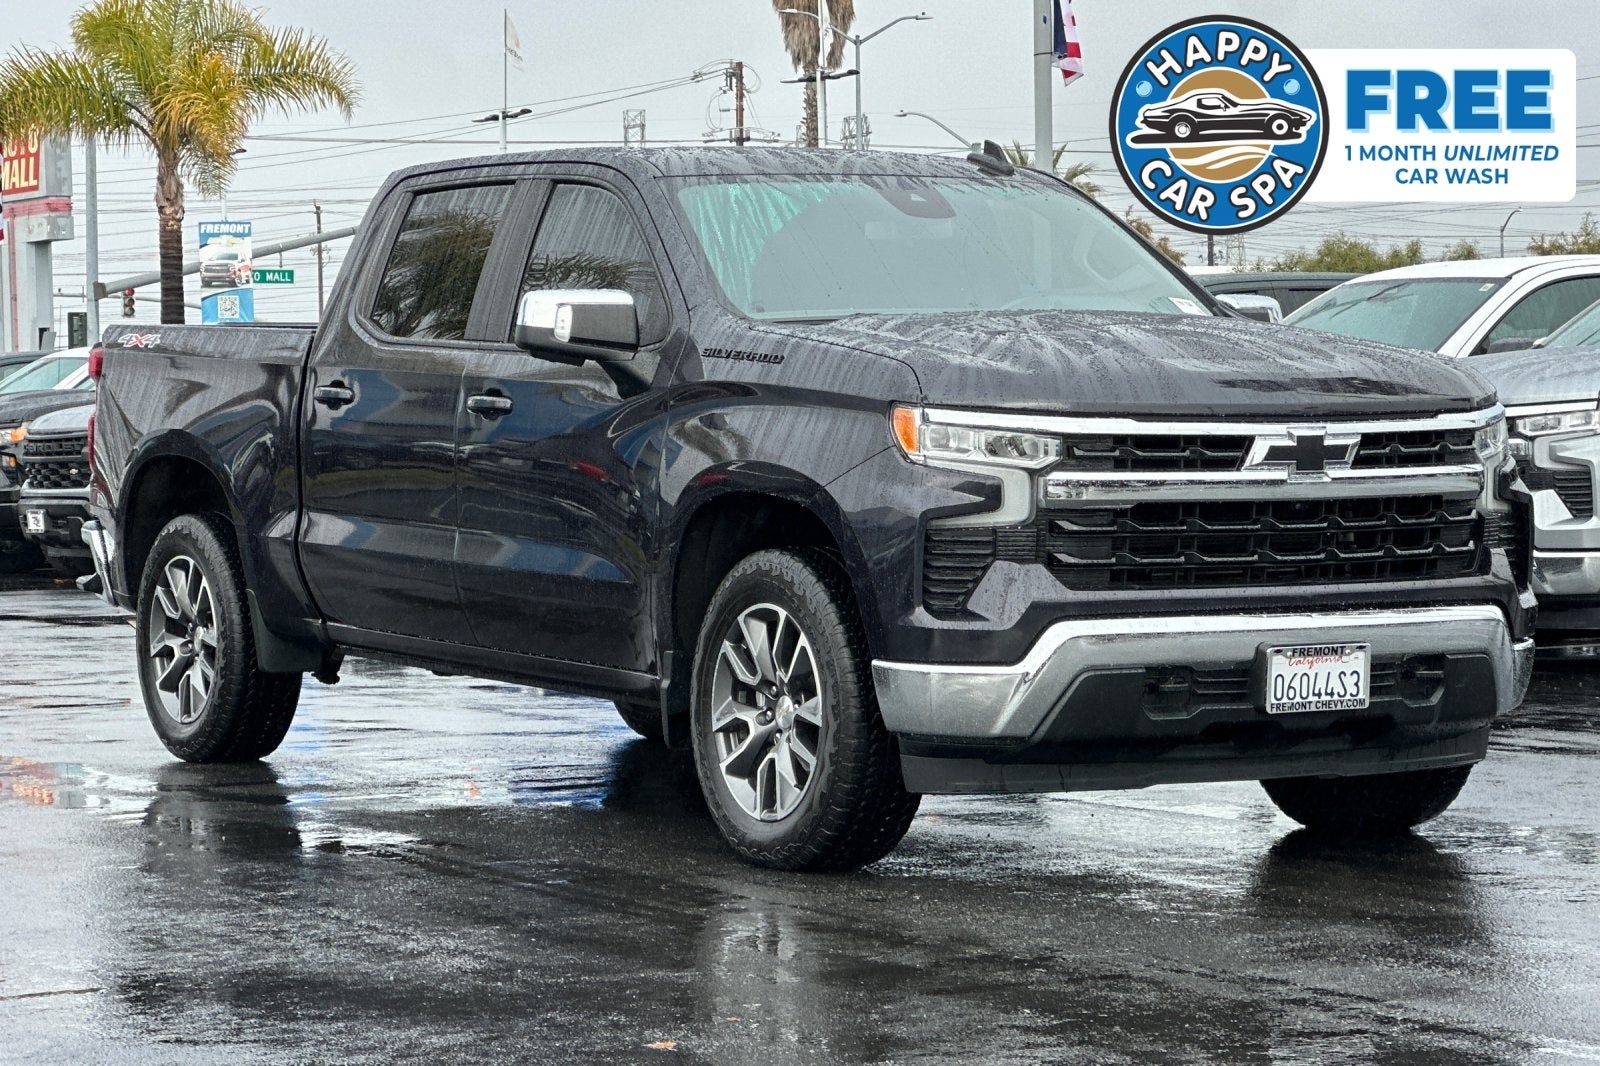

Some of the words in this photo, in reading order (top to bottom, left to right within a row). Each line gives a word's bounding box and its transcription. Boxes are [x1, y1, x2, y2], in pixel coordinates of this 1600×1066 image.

[201, 223, 250, 234] FREMONT
[266, 272, 291, 281] MALL
[701, 348, 785, 364] SILVERADO
[1292, 645, 1346, 657] FREMONT
[1289, 655, 1350, 670] California
[1273, 670, 1360, 702] 06044S3
[1270, 701, 1312, 712] FREMONT
[1315, 698, 1366, 710] CHEVY.COM
